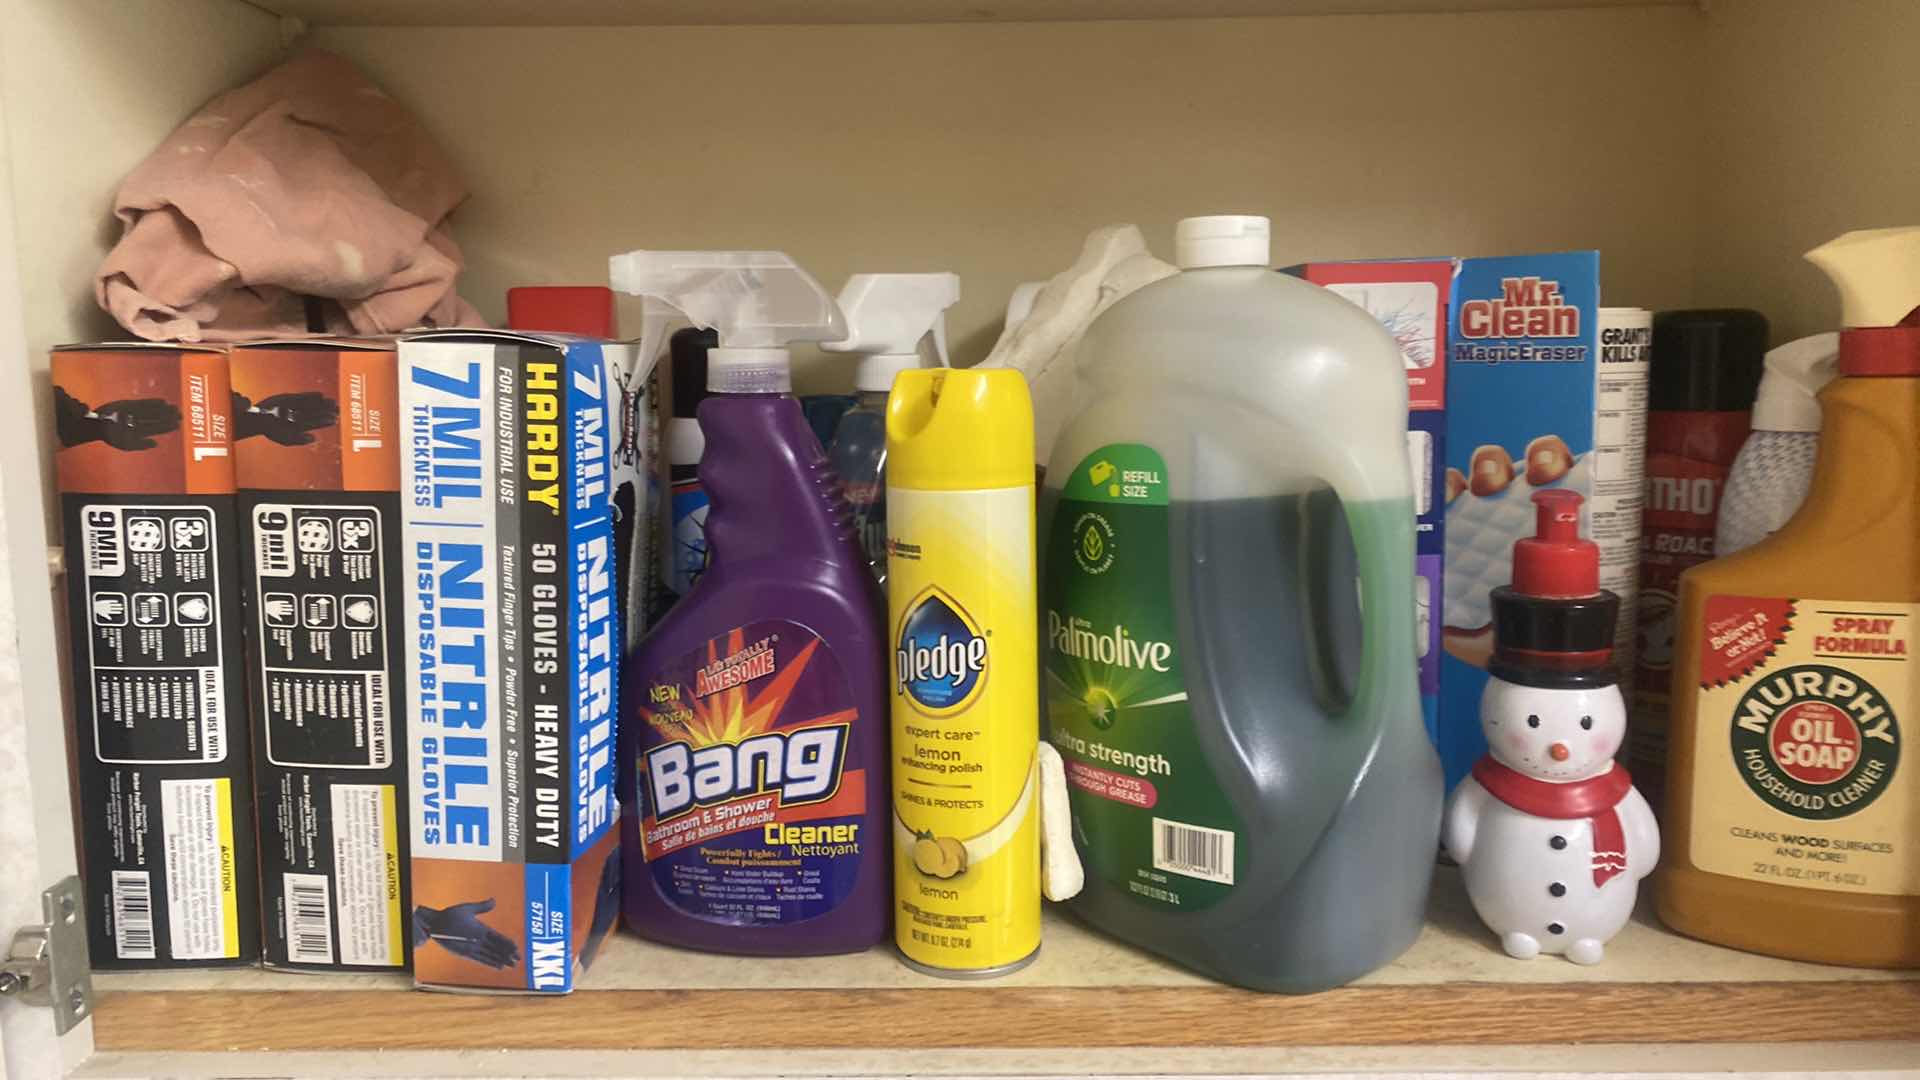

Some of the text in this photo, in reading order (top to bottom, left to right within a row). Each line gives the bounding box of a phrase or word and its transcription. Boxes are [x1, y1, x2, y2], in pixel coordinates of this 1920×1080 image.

[1504, 277, 1562, 308] Mr.
[1461, 300, 1580, 338] Clean
[1455, 345, 1587, 365] MagicEraser
[190, 376, 205, 438] ITEM 68511
[350, 374, 362, 431] ITEM 68511
[368, 410, 381, 432] SIZE
[212, 415, 226, 438] SIZE
[353, 440, 382, 452] L
[411, 361, 482, 509] 7 MIL
[499, 366, 514, 505] FOR INDUSTRIAL USE
[526, 361, 559, 510] HARDY
[574, 364, 605, 509] 7 MIL
[194, 448, 228, 461] L
[412, 405, 431, 507] THICKNESS
[575, 409, 586, 511] THICKNESS
[1122, 471, 1160, 483] REFILL
[1122, 486, 1148, 497] SIZE
[88, 511, 117, 569] 9 MIL
[258, 512, 288, 570] 9 mil
[531, 543, 557, 573] 50
[532, 580, 558, 675] GLOVES
[1048, 609, 1171, 673] Palmolive
[1814, 636, 1906, 655] FORMULA
[1833, 617, 1894, 635] SPRAY
[696, 649, 775, 698] AWESOME
[897, 635, 986, 695] pledge
[416, 541, 441, 846] DISPOSABLE GLOVES
[438, 543, 489, 847] NITRILE
[502, 544, 520, 849] Textured Finger Tips Powder Free Superior Protection
[577, 543, 590, 844] DISPOSABLE GLOVES
[587, 535, 611, 836] NITRILE
[649, 684, 681, 703] NEW
[204, 670, 219, 759] IDEAL FOR USE WITH
[371, 674, 385, 764] IDEAL FOR USE WITH
[1736, 671, 1895, 746] MURPHY
[533, 703, 559, 778] HEAVY
[906, 726, 940, 739] expert
[1791, 718, 1841, 744] OIL
[650, 726, 841, 816] Bang
[901, 757, 983, 773] enhancing polish
[914, 744, 961, 761] lemon
[1090, 742, 1171, 776] strength
[1779, 741, 1854, 770] SOAP
[1108, 786, 1148, 804] GREASE
[1115, 776, 1141, 791] CUTS
[1743, 748, 1887, 810] HOUSEHOLD CLEANER
[535, 788, 559, 849] DUTY
[648, 798, 772, 845] Bathroom & Shower
[934, 799, 984, 809] PROTECTS
[685, 831, 696, 844] de
[726, 820, 736, 833] et
[738, 812, 776, 833] douche
[764, 823, 859, 845] Cleaner
[1730, 827, 1894, 853] CLEANS WOOD SURFACES
[791, 844, 859, 858] Nettoyant
[1776, 848, 1803, 859] AND
[221, 852, 232, 892] CAUTION
[387, 860, 396, 900] CAUTION
[919, 883, 959, 900] lemon
[531, 902, 543, 935] 57158
[551, 911, 563, 935] SIZE
[532, 941, 564, 989] XXL
